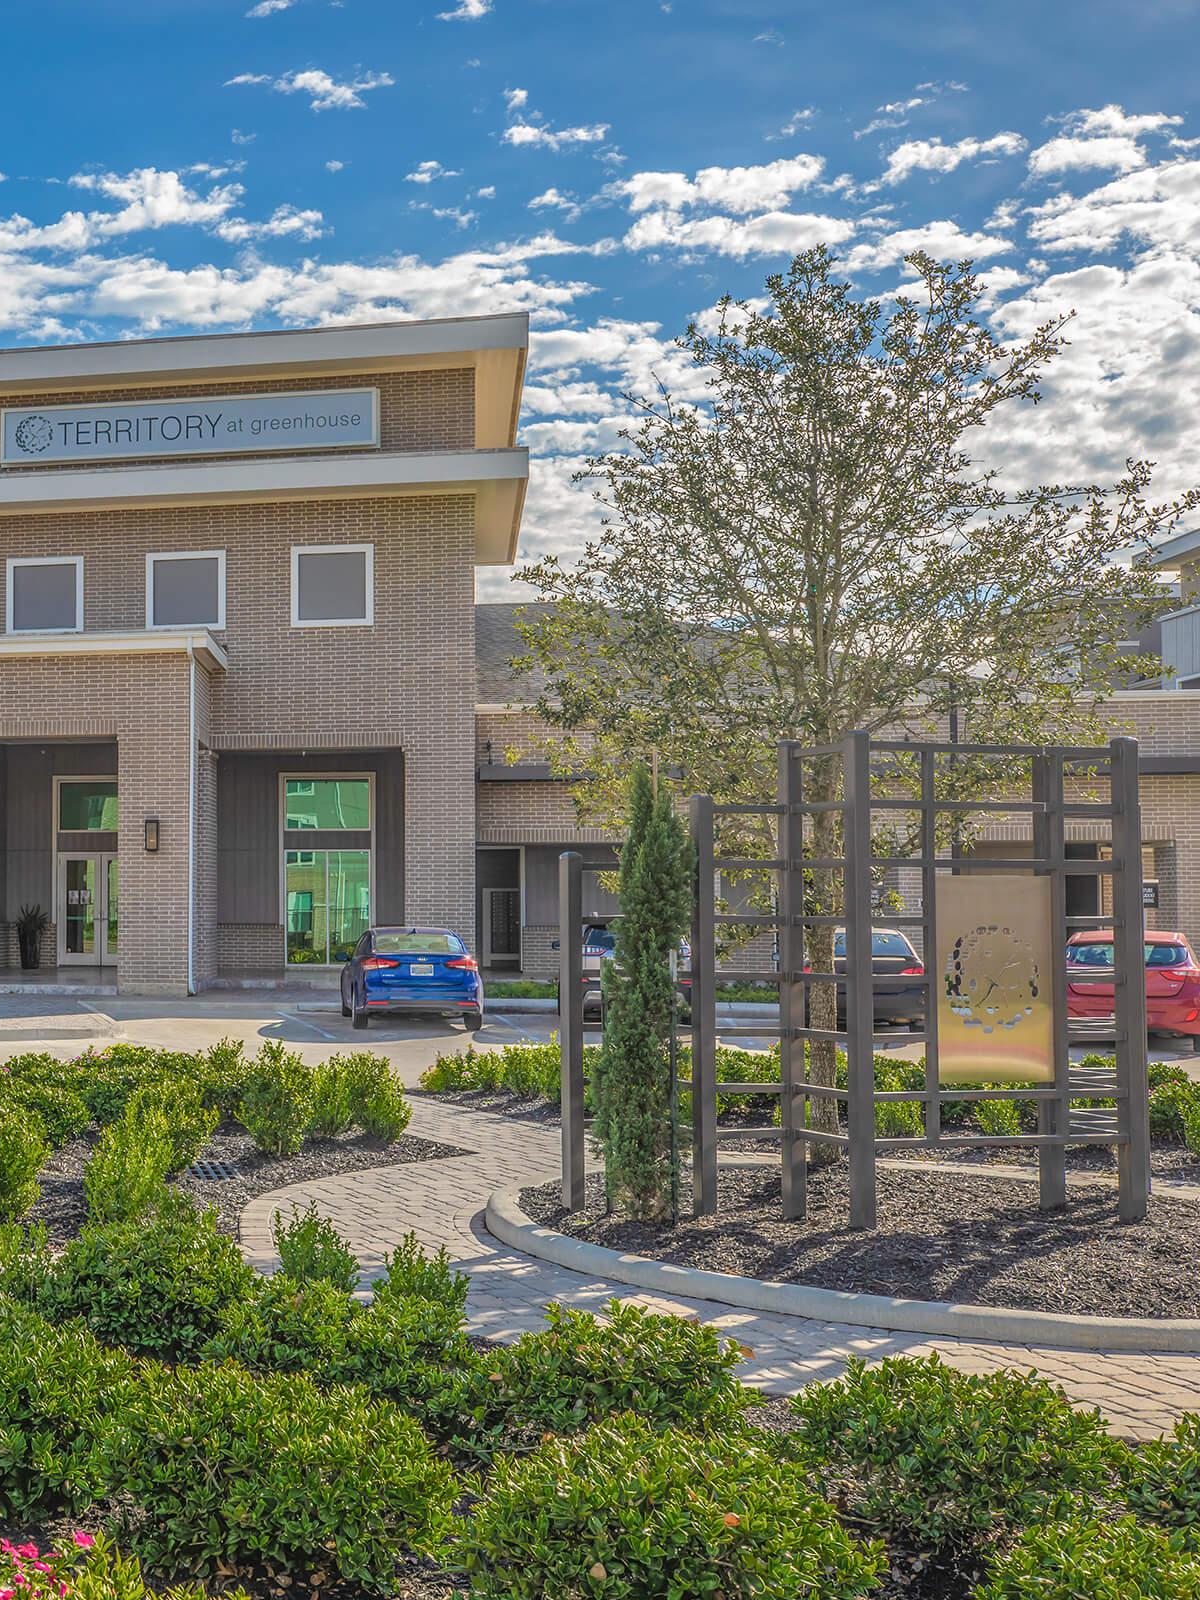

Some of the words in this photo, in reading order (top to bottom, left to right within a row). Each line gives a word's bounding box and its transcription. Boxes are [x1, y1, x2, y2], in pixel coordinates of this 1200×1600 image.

[57, 413, 223, 446] TERRITORY
[226, 417, 244, 433] at
[250, 413, 361, 435] greenhouse
